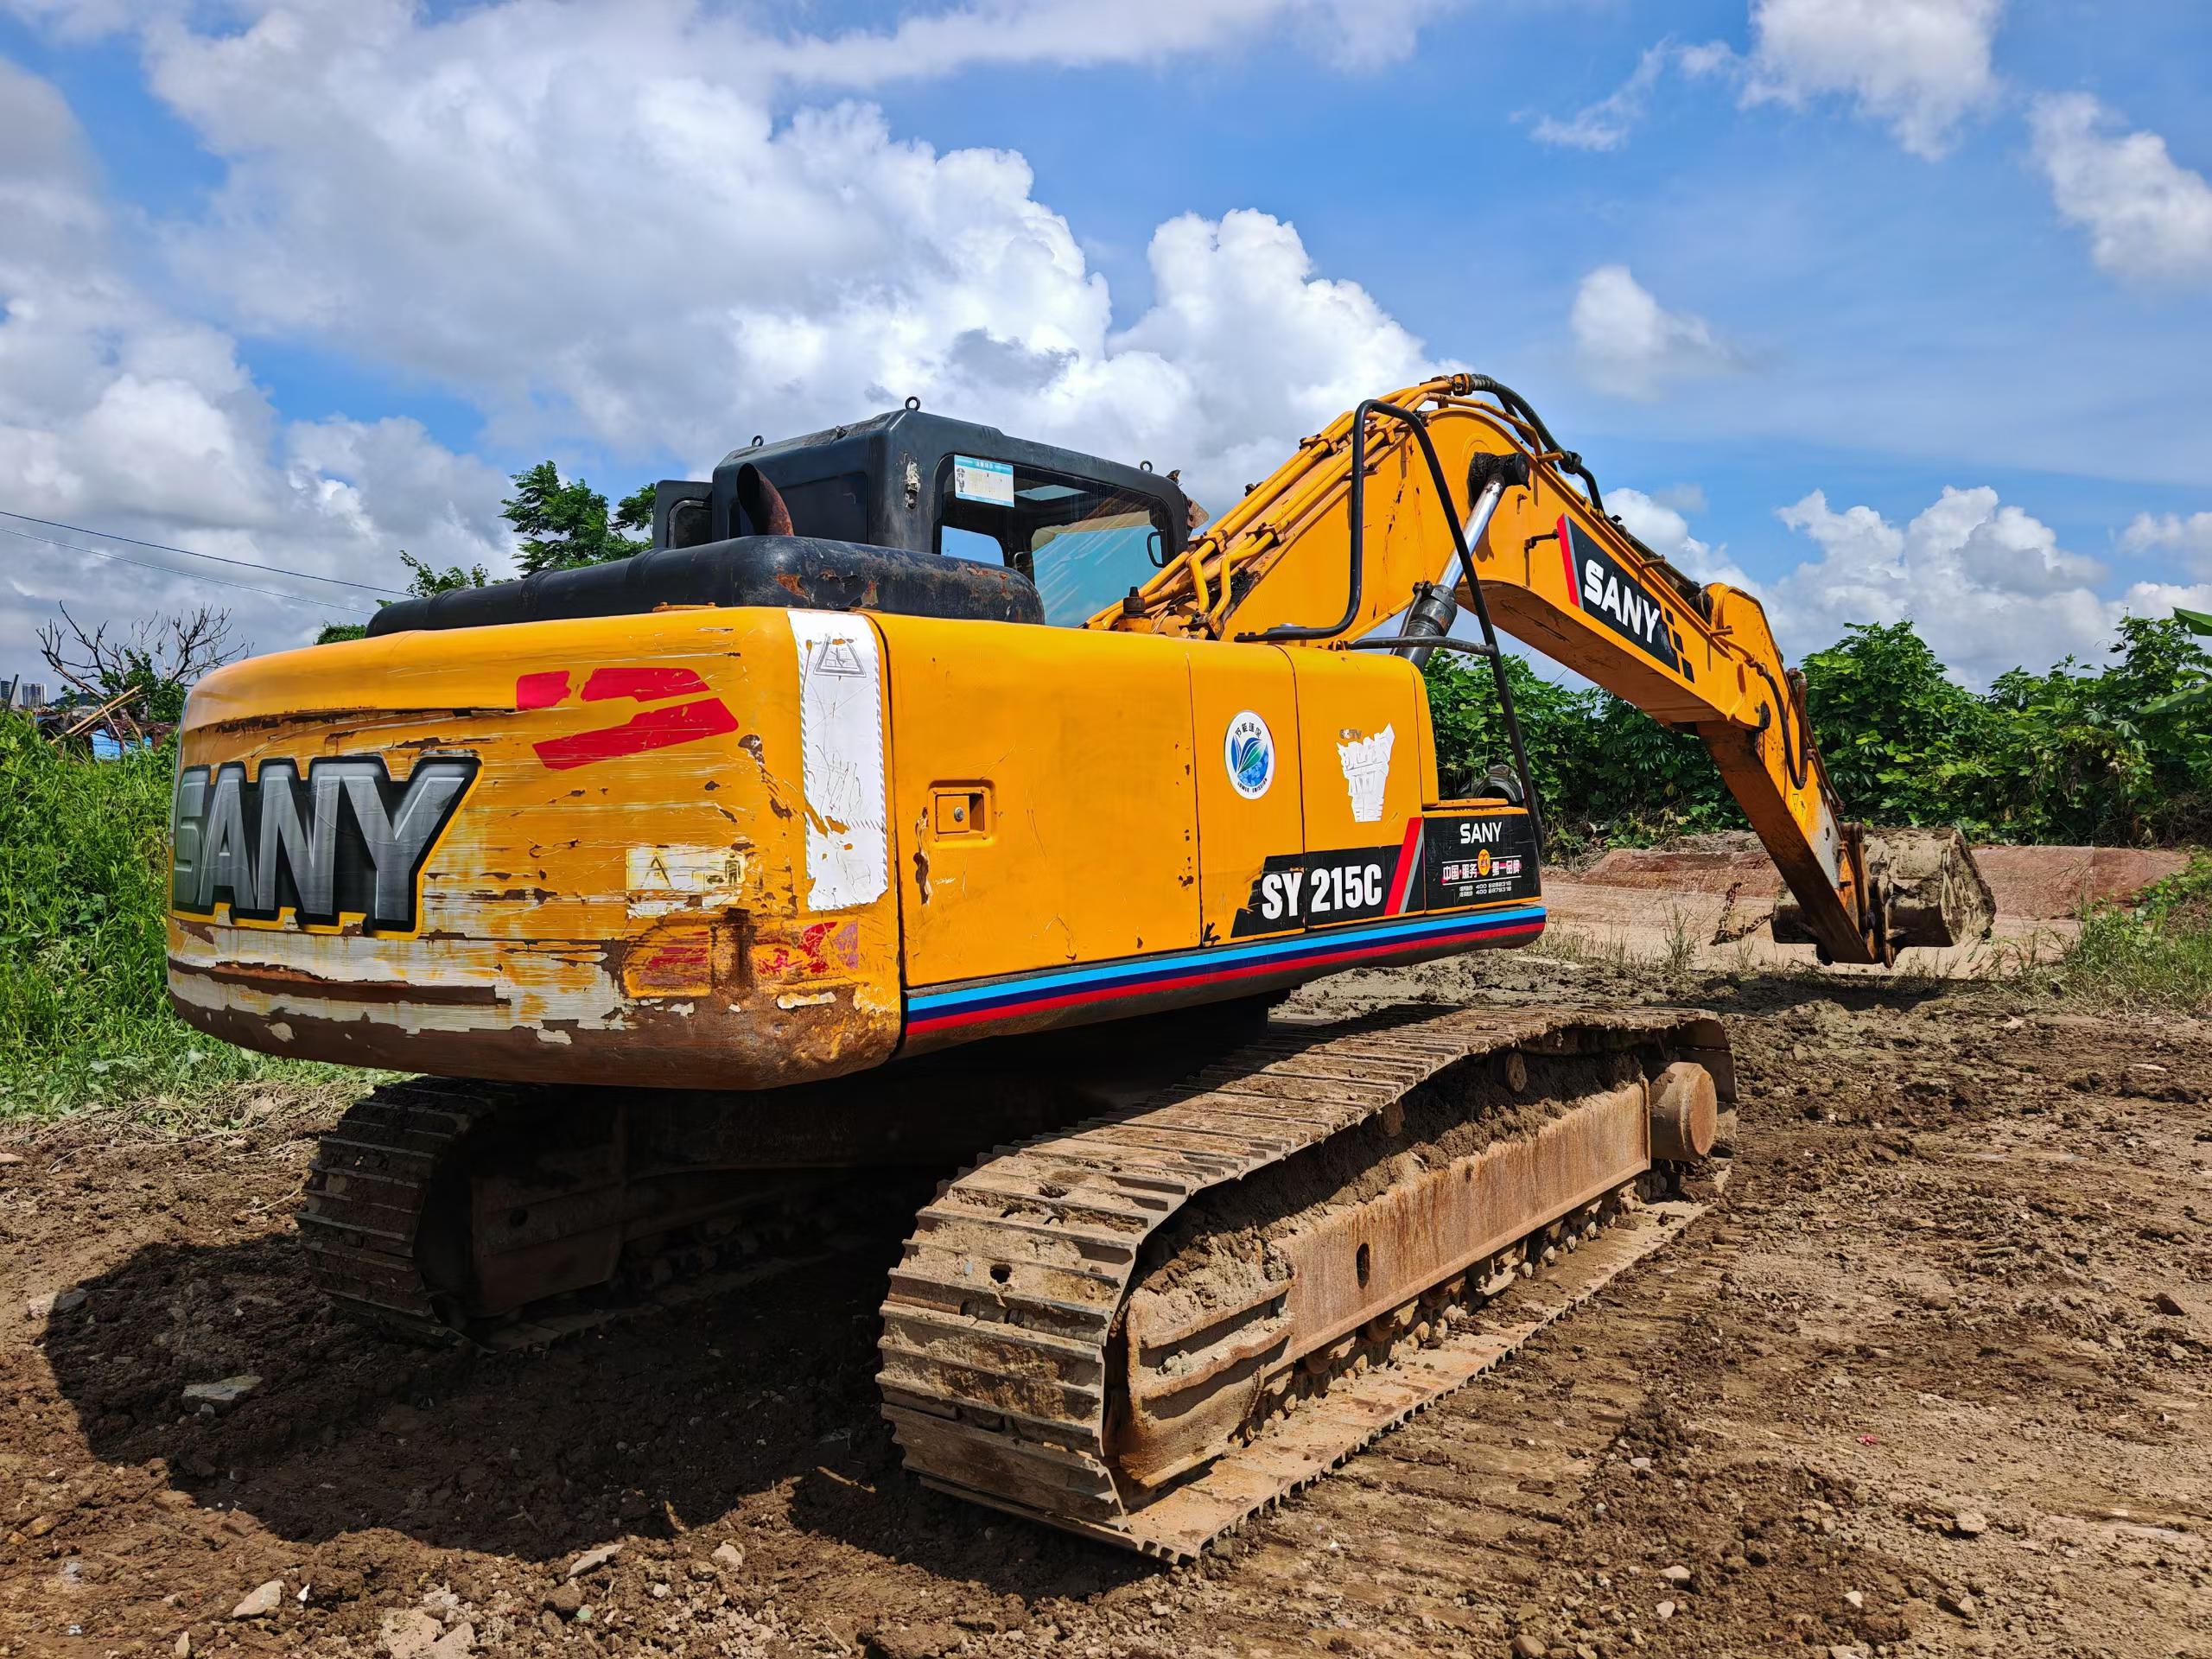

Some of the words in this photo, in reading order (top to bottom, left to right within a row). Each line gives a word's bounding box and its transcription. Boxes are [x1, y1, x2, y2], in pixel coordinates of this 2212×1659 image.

[1585, 559, 1661, 644] SANY
[173, 764, 472, 924] SANY
[1460, 822, 1503, 844] SANY
[1262, 873, 1303, 919] SY
[1311, 864, 1382, 912] 215C
